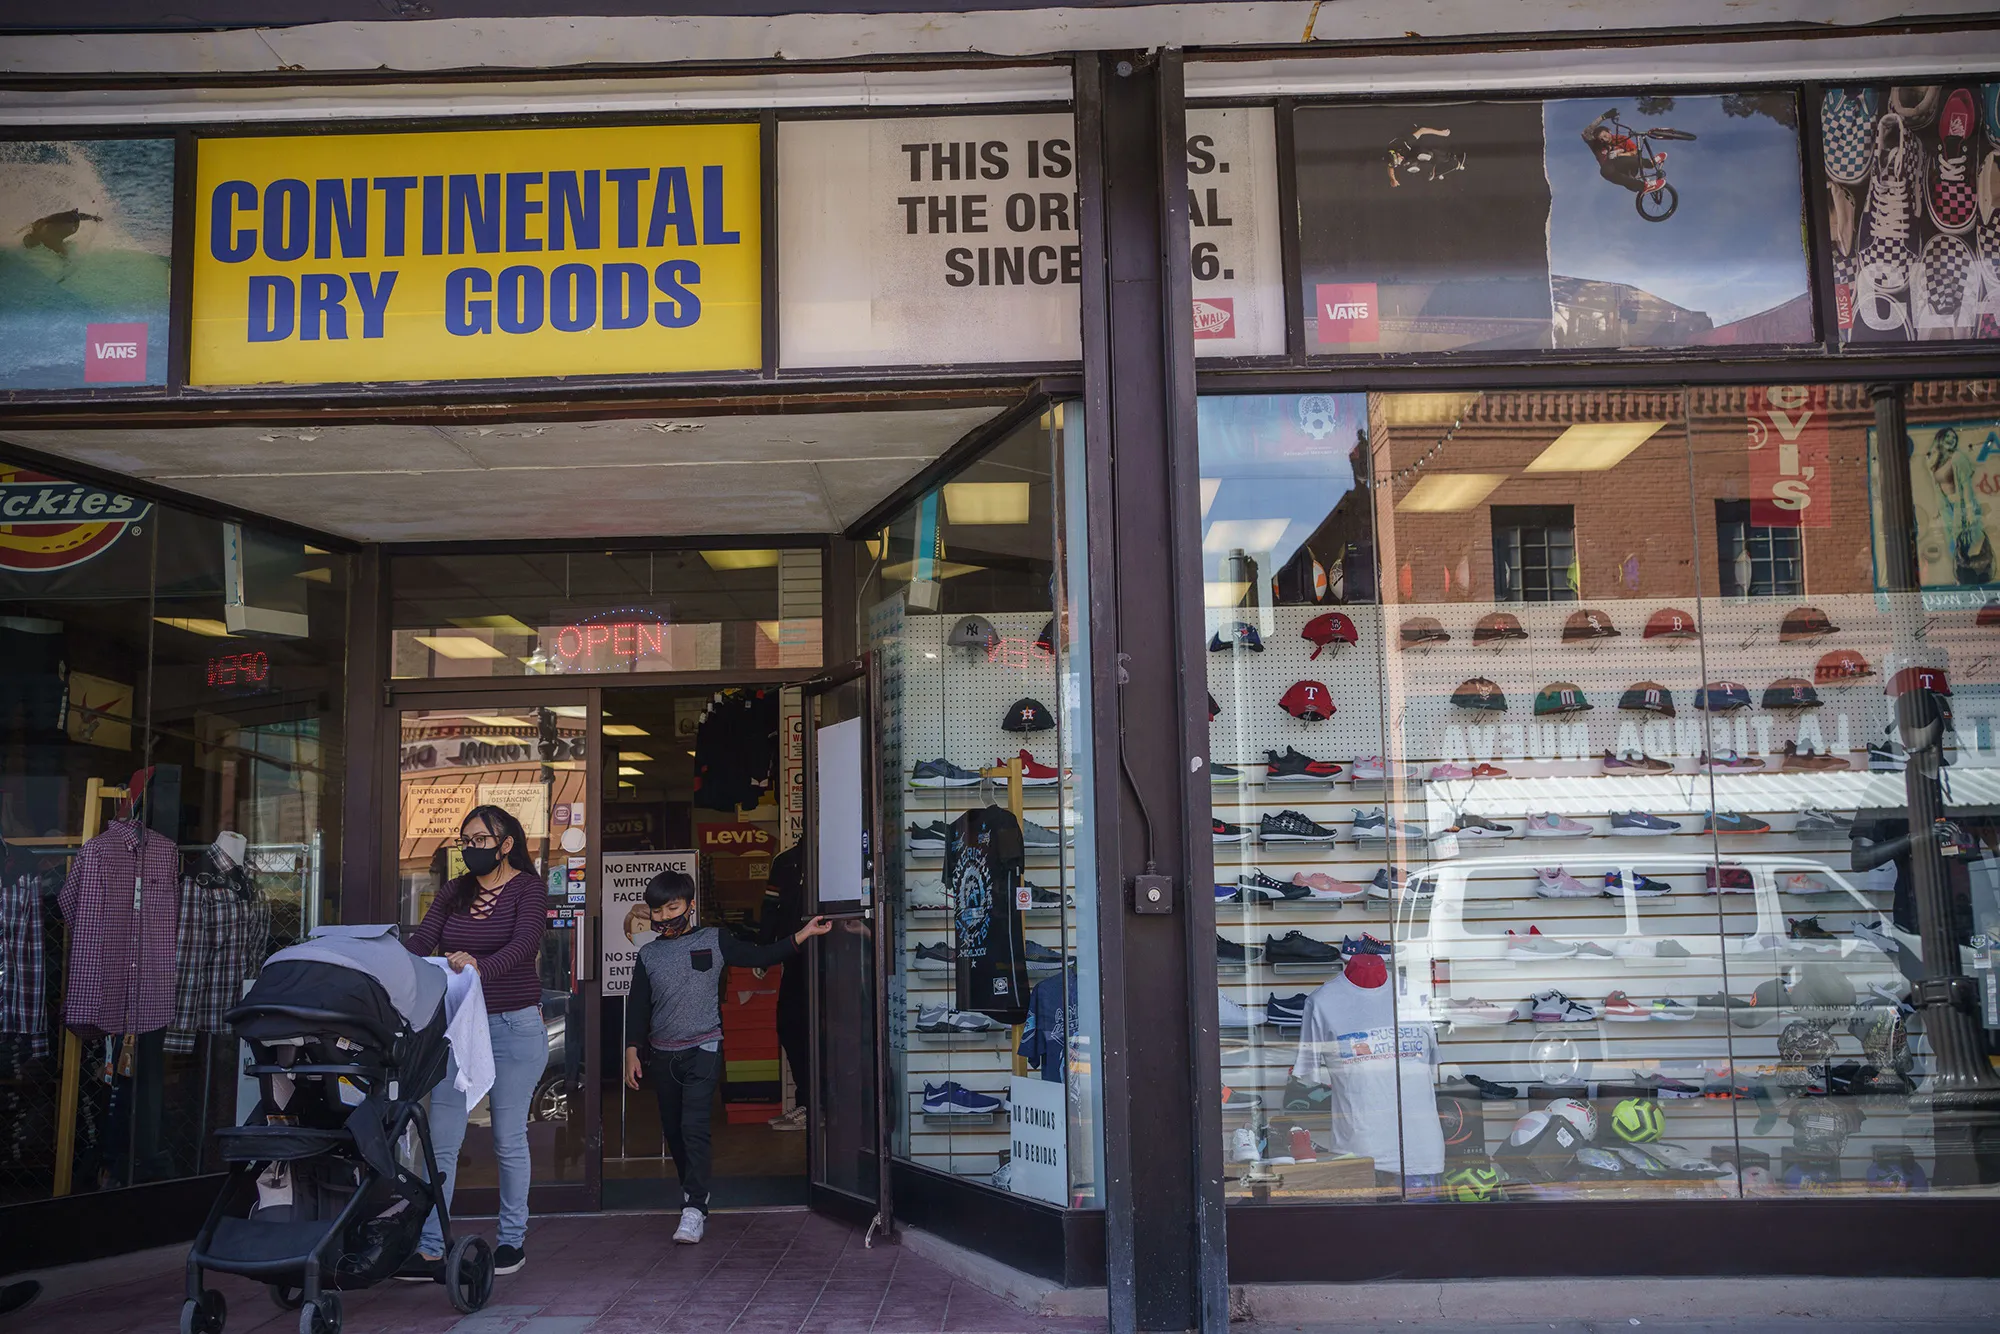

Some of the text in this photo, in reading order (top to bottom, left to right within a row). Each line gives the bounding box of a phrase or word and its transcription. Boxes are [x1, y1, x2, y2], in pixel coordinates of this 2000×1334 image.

[901, 138, 1073, 183] THIS IS
[210, 165, 740, 263] CONTINENTAL
[898, 195, 988, 235] THE
[945, 246, 1081, 287] SINCE
[247, 259, 702, 343] DRY GOODS
[1325, 301, 1369, 320] VANS
[1838, 294, 1849, 326] VANS
[95, 342, 137, 360] VANS
[0, 488, 135, 516] ckies
[557, 622, 662, 658] OPEN
[411, 787, 458, 795] ENTRANCE
[605, 861, 687, 874] NO ENTRANCE
[613, 877, 651, 888] WITHO
[613, 891, 645, 902] FACE
[605, 952, 623, 962] NO
[1013, 1104, 1056, 1131] NO COMIDAS
[1013, 1140, 1057, 1167] NO BEBIDAS
